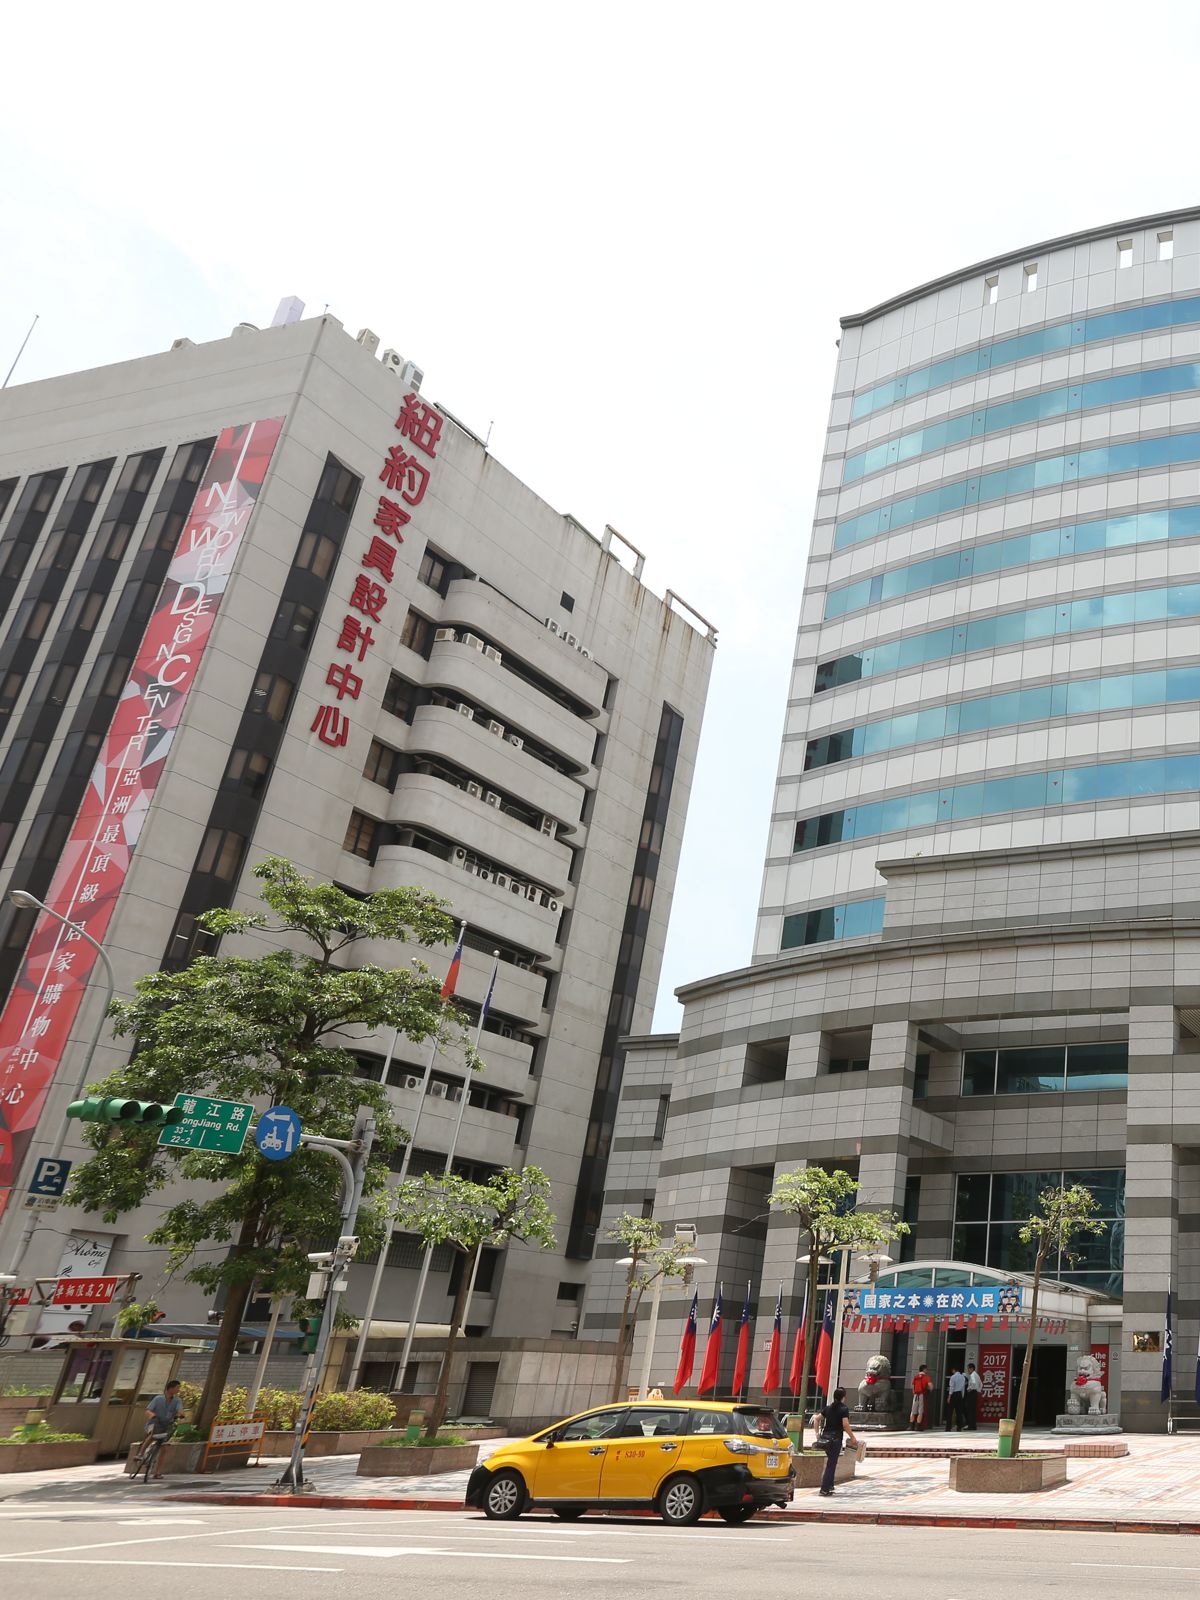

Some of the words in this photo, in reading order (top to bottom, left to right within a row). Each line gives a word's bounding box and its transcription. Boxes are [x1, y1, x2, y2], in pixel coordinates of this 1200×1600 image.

[310, 392, 445, 748] 紐約家具設計中心
[182, 1098, 245, 1121] 龍江路
[181, 1116, 222, 1131] ongJiang
[226, 1122, 240, 1132] Rd.
[37, 1161, 61, 1183] P
[863, 1293, 921, 1309] 國家之本
[936, 1293, 994, 1309] 在於人民
[983, 1355, 1007, 1366] 2017
[982, 1369, 1006, 1384] 食安
[982, 1384, 1005, 1398] 元年
